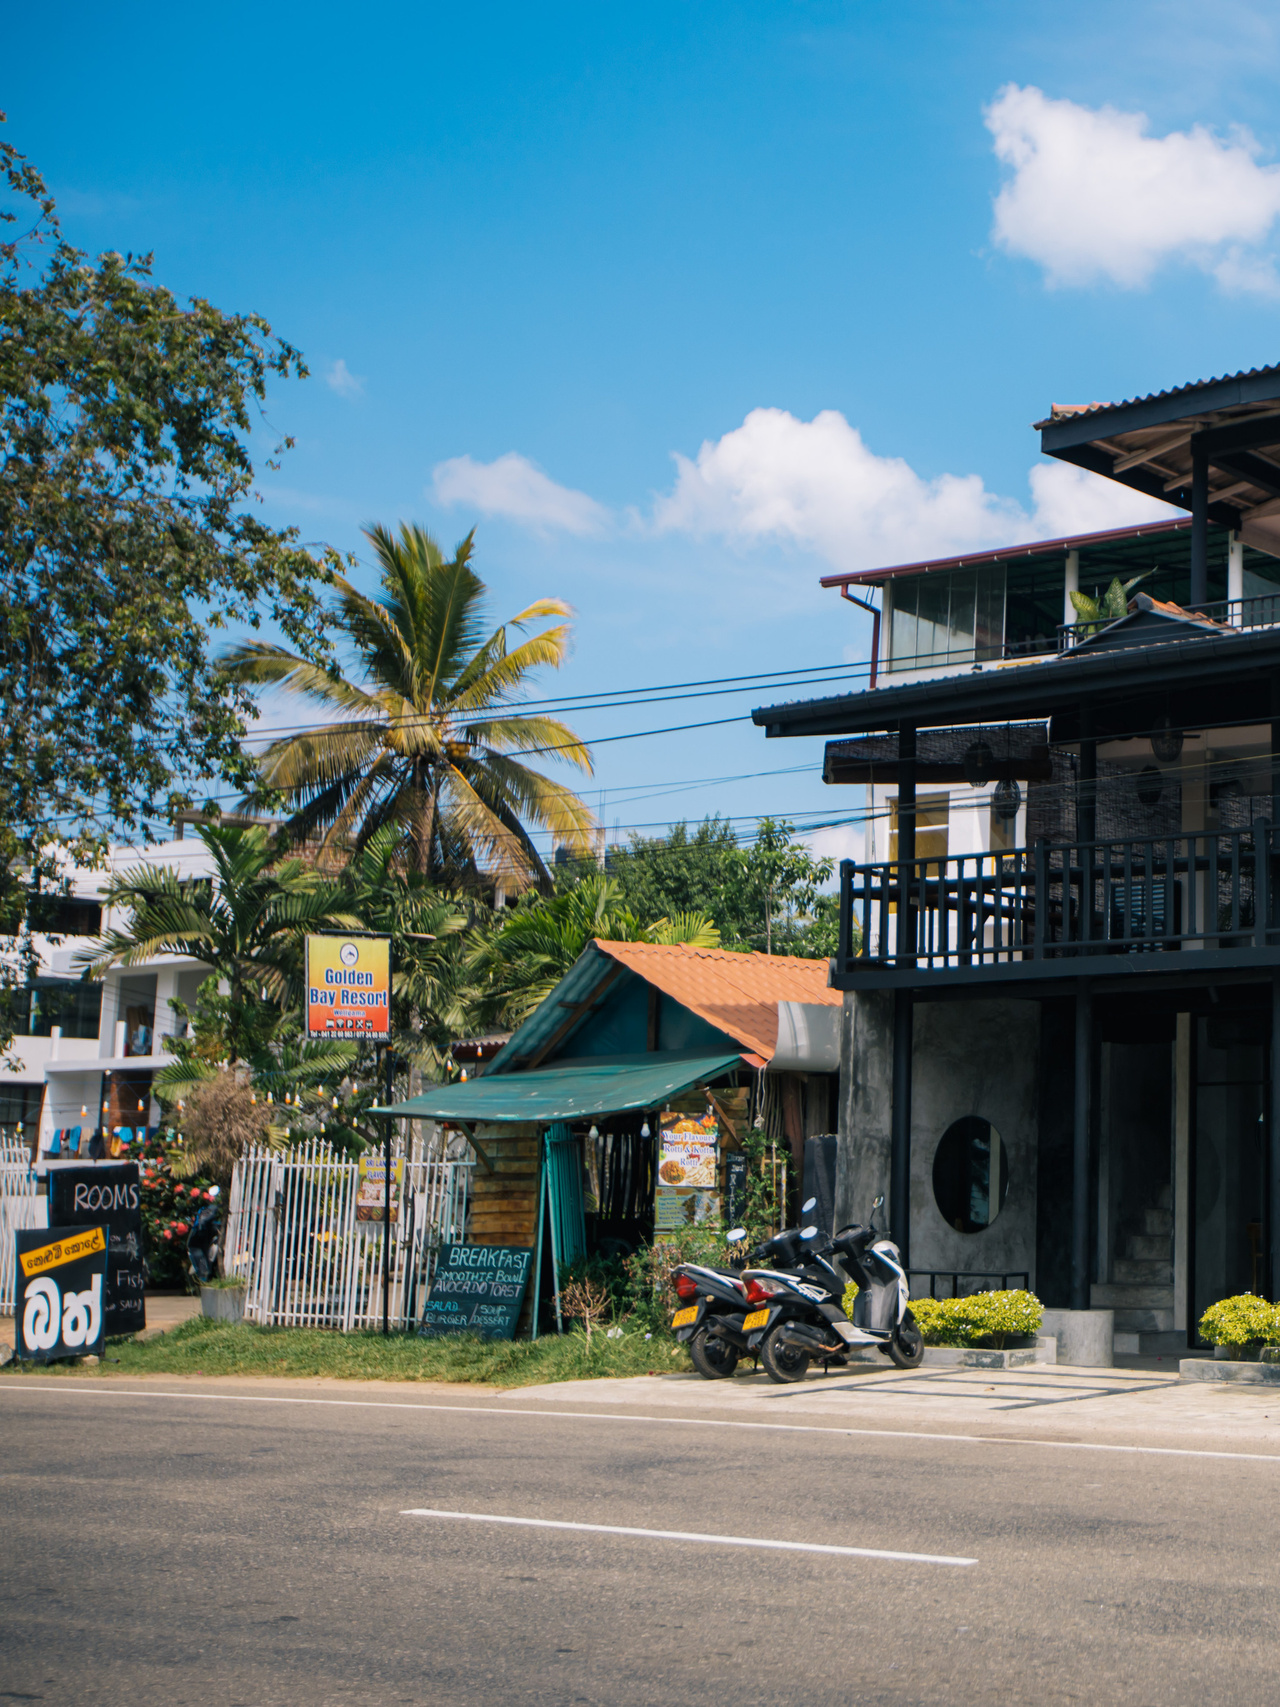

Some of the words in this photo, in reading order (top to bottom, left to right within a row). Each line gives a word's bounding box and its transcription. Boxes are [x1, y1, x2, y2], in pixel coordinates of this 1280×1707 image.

[325, 968, 373, 986] Golden
[310, 988, 336, 1006] Bay
[341, 989, 387, 1007] Resort
[663, 1130, 681, 1141] Your
[684, 1132, 715, 1142] Flavours
[664, 1144, 682, 1153] Rotti
[680, 1158, 698, 1166] Rotti
[74, 1183, 139, 1211] ROOMS
[449, 1246, 531, 1269] BREAKFAST
[436, 1267, 494, 1282] SMOOTHIE
[433, 1278, 488, 1295] AVOCADO
[489, 1282, 522, 1298] TOAST
[22, 1273, 102, 1351] බත්
[426, 1300, 459, 1312] SALAD
[480, 1305, 507, 1316] SOUP
[425, 1313, 468, 1326] BURGER
[472, 1315, 511, 1326] DESSERT
